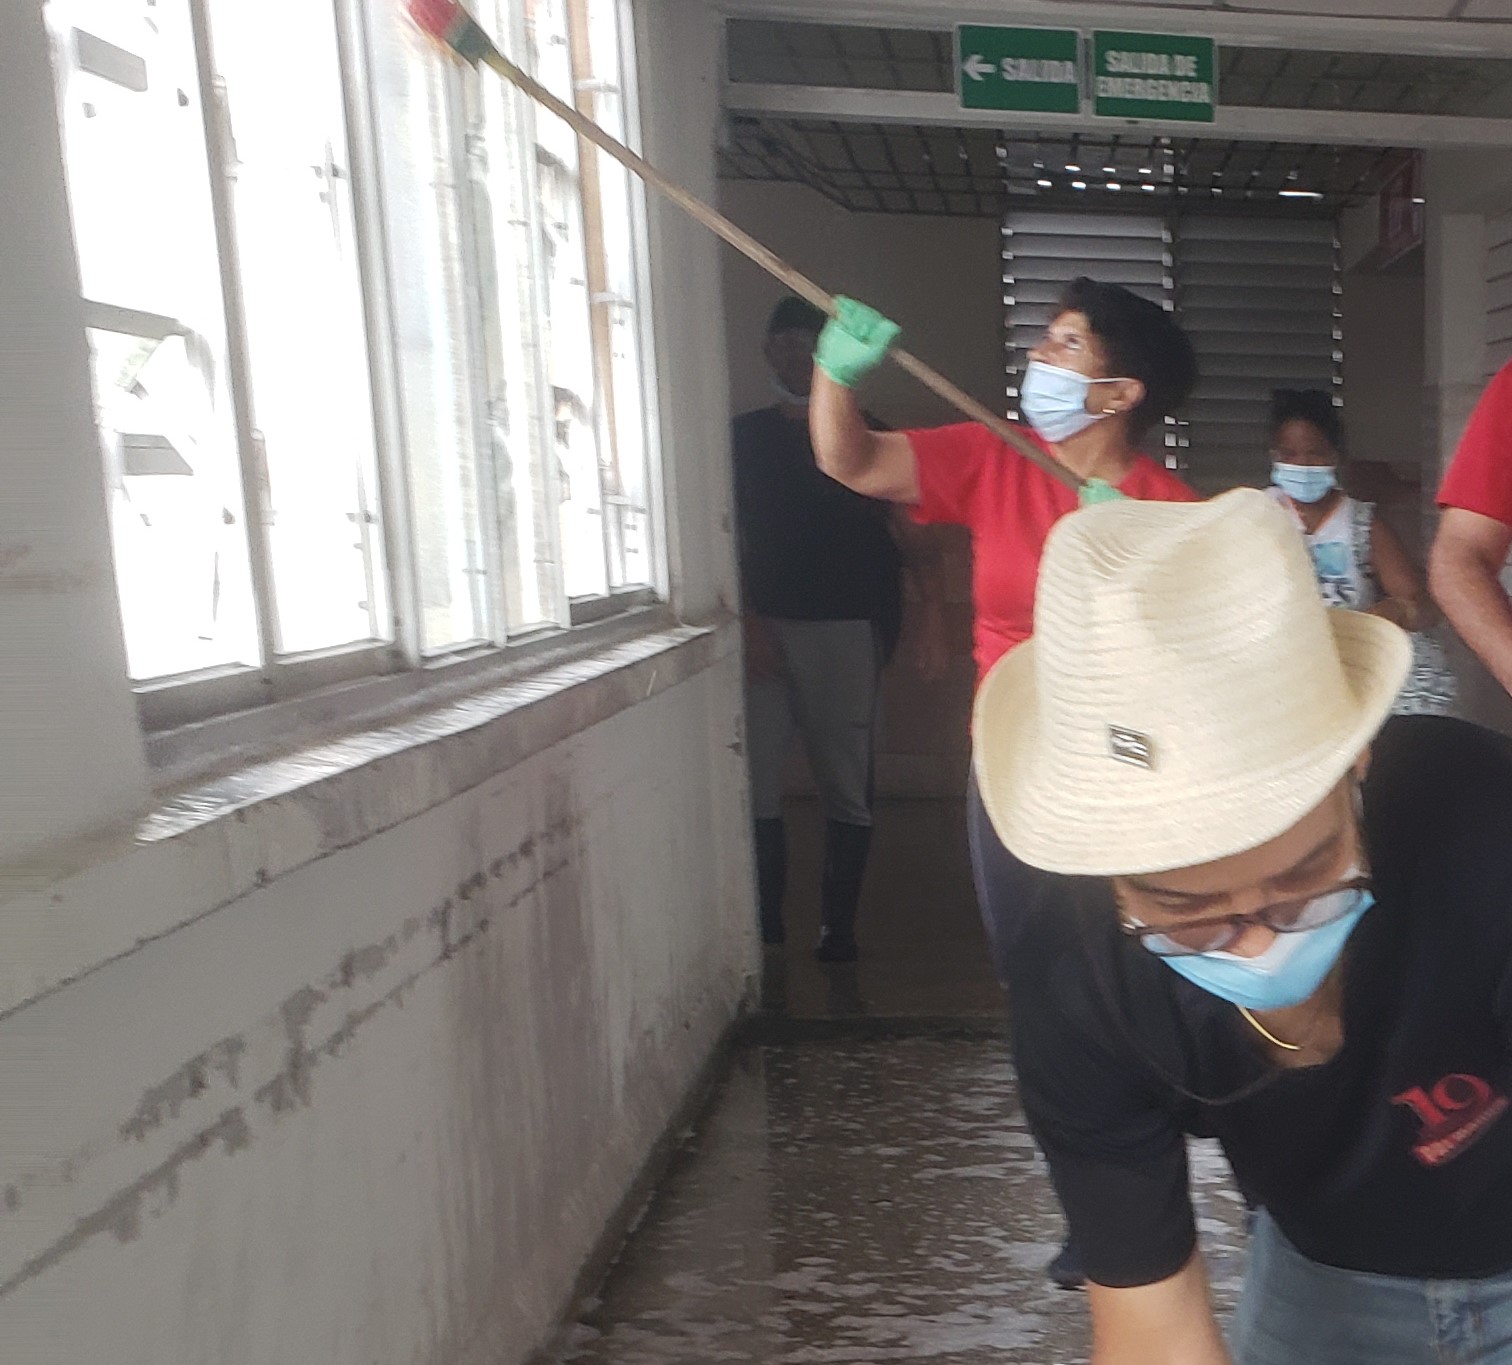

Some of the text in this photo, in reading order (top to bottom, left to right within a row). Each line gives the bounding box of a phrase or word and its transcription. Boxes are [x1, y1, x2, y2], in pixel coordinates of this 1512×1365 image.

[1002, 57, 1076, 83] SALIDA
[1104, 50, 1198, 77] SALIDA DE
[1096, 76, 1210, 103] EMERGENCIA
